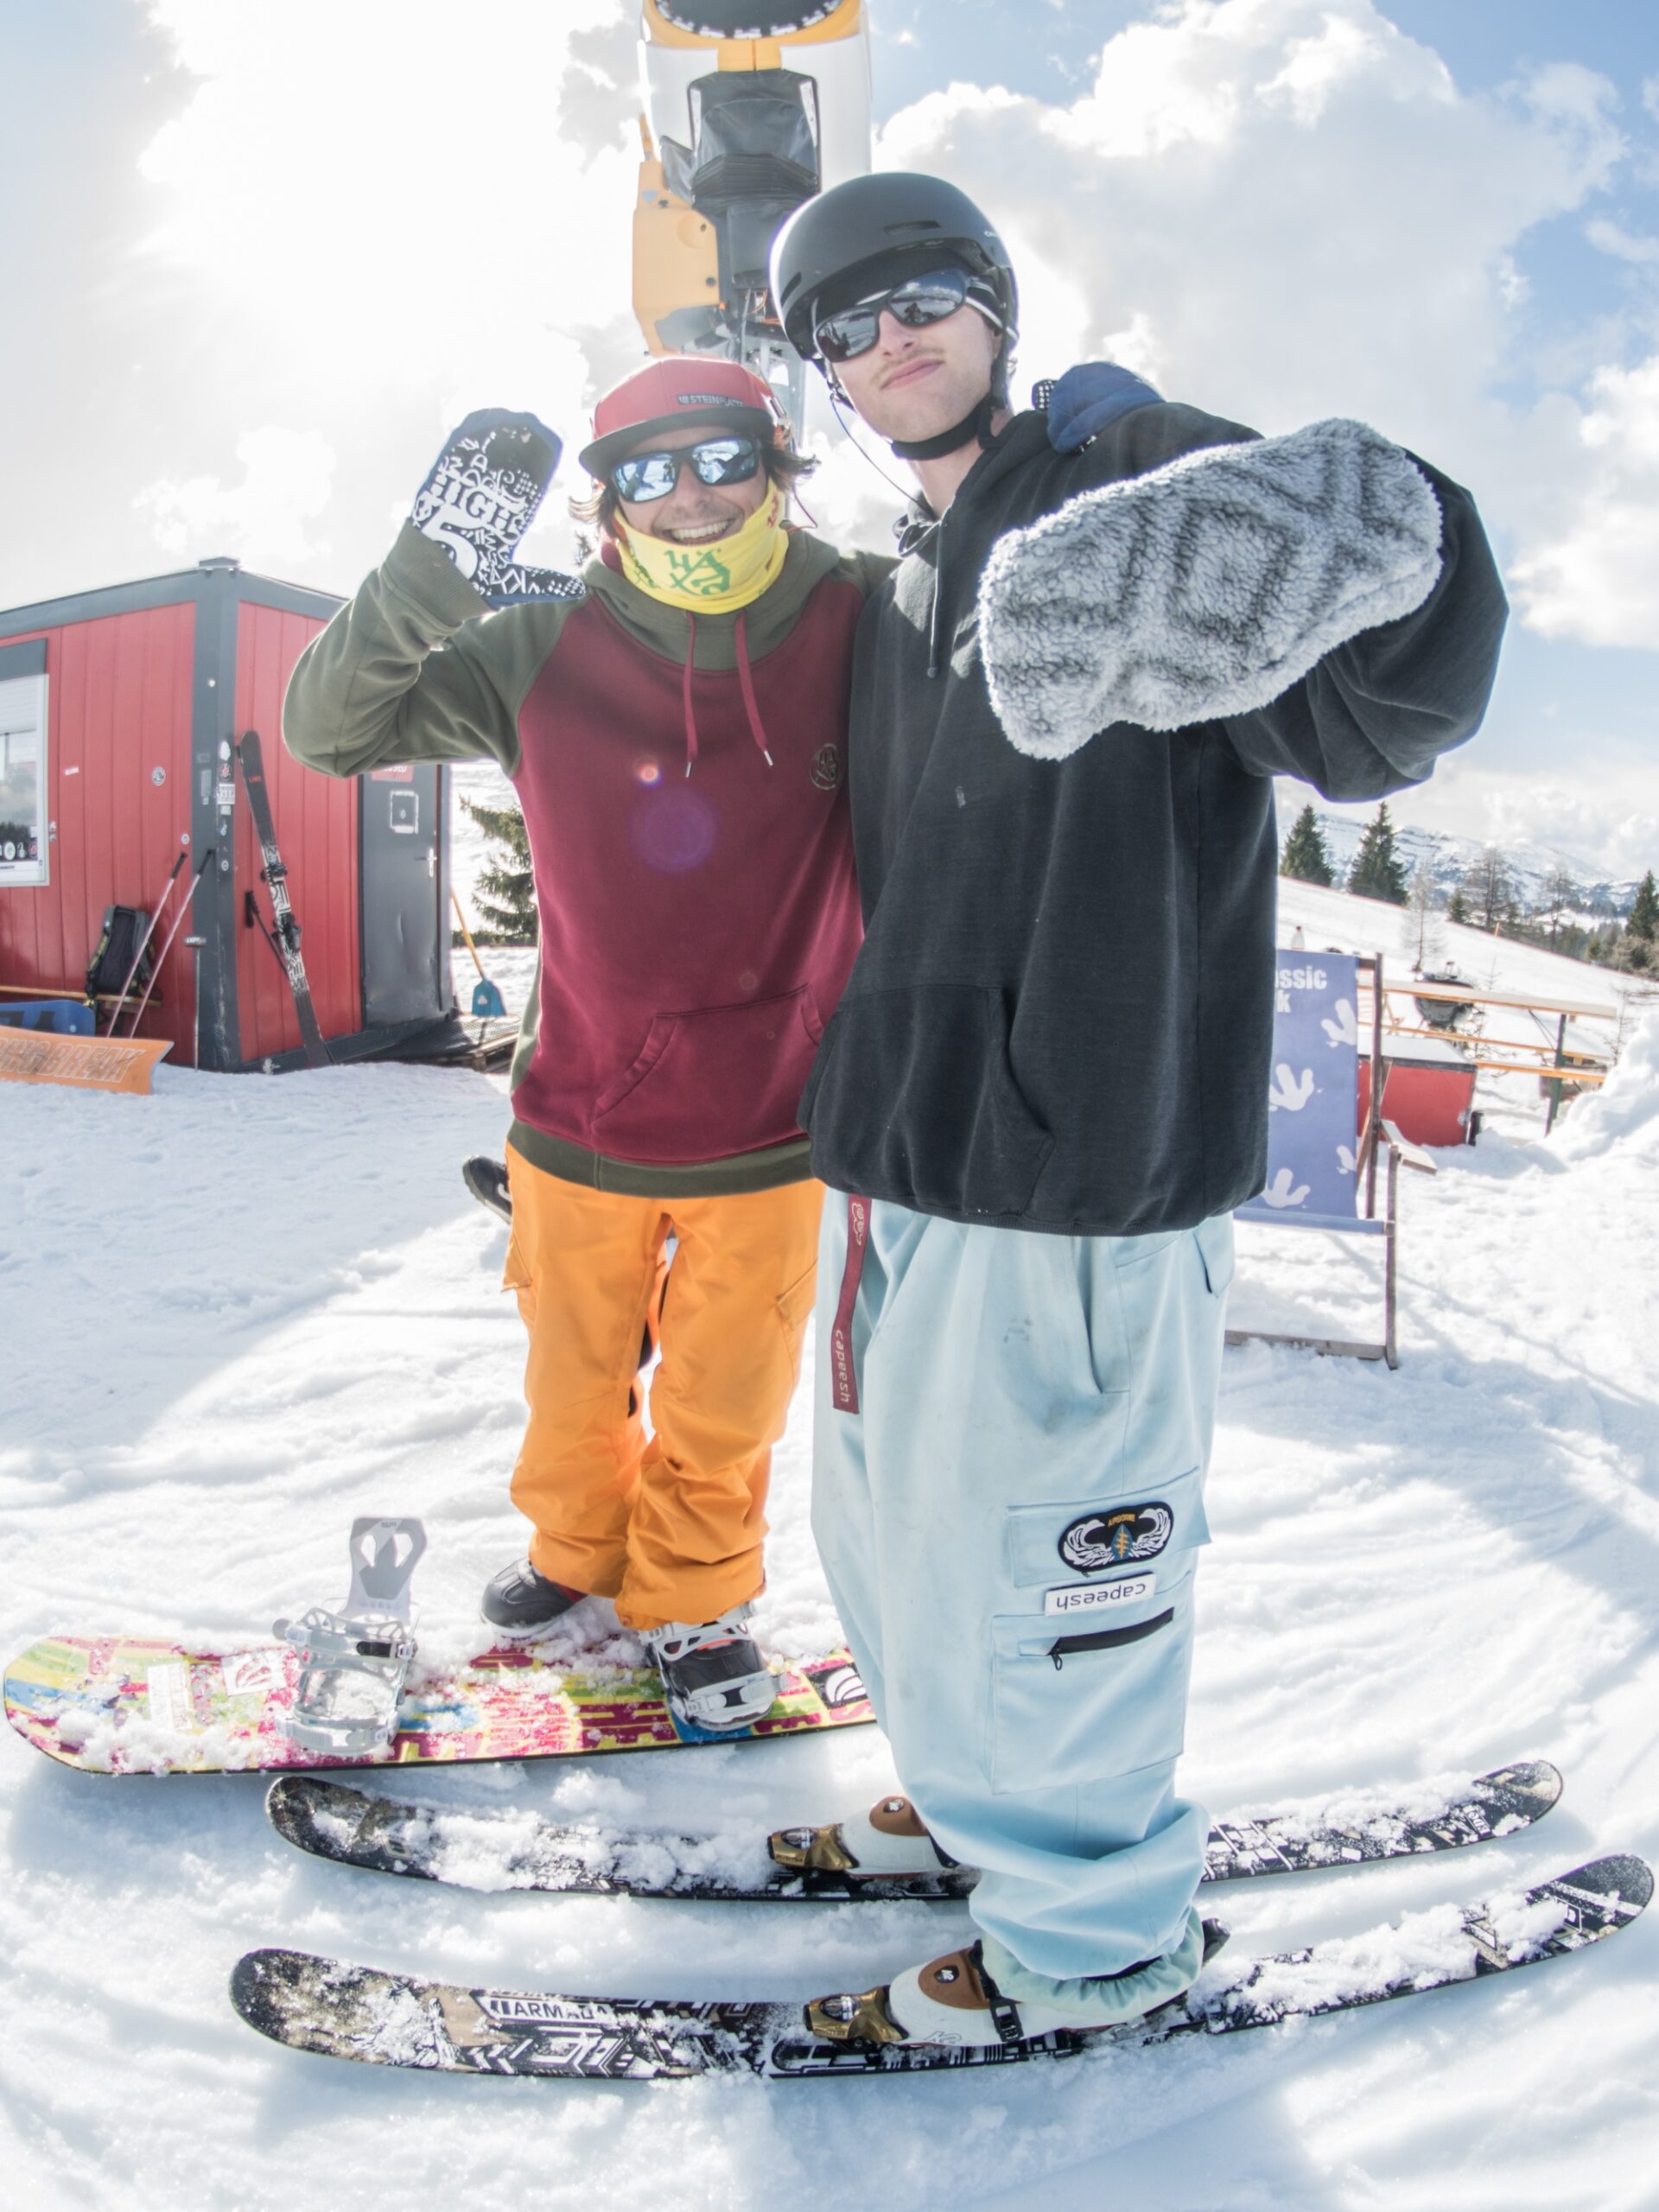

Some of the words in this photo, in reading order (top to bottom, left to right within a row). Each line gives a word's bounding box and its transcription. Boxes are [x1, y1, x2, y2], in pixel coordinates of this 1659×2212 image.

[427, 473, 526, 536] HIGH
[1275, 964, 1328, 990] ssic
[36, 1042, 146, 1084] BREAK
[834, 1328, 852, 1403] capeesh
[1056, 1583, 1147, 1611] capeesh
